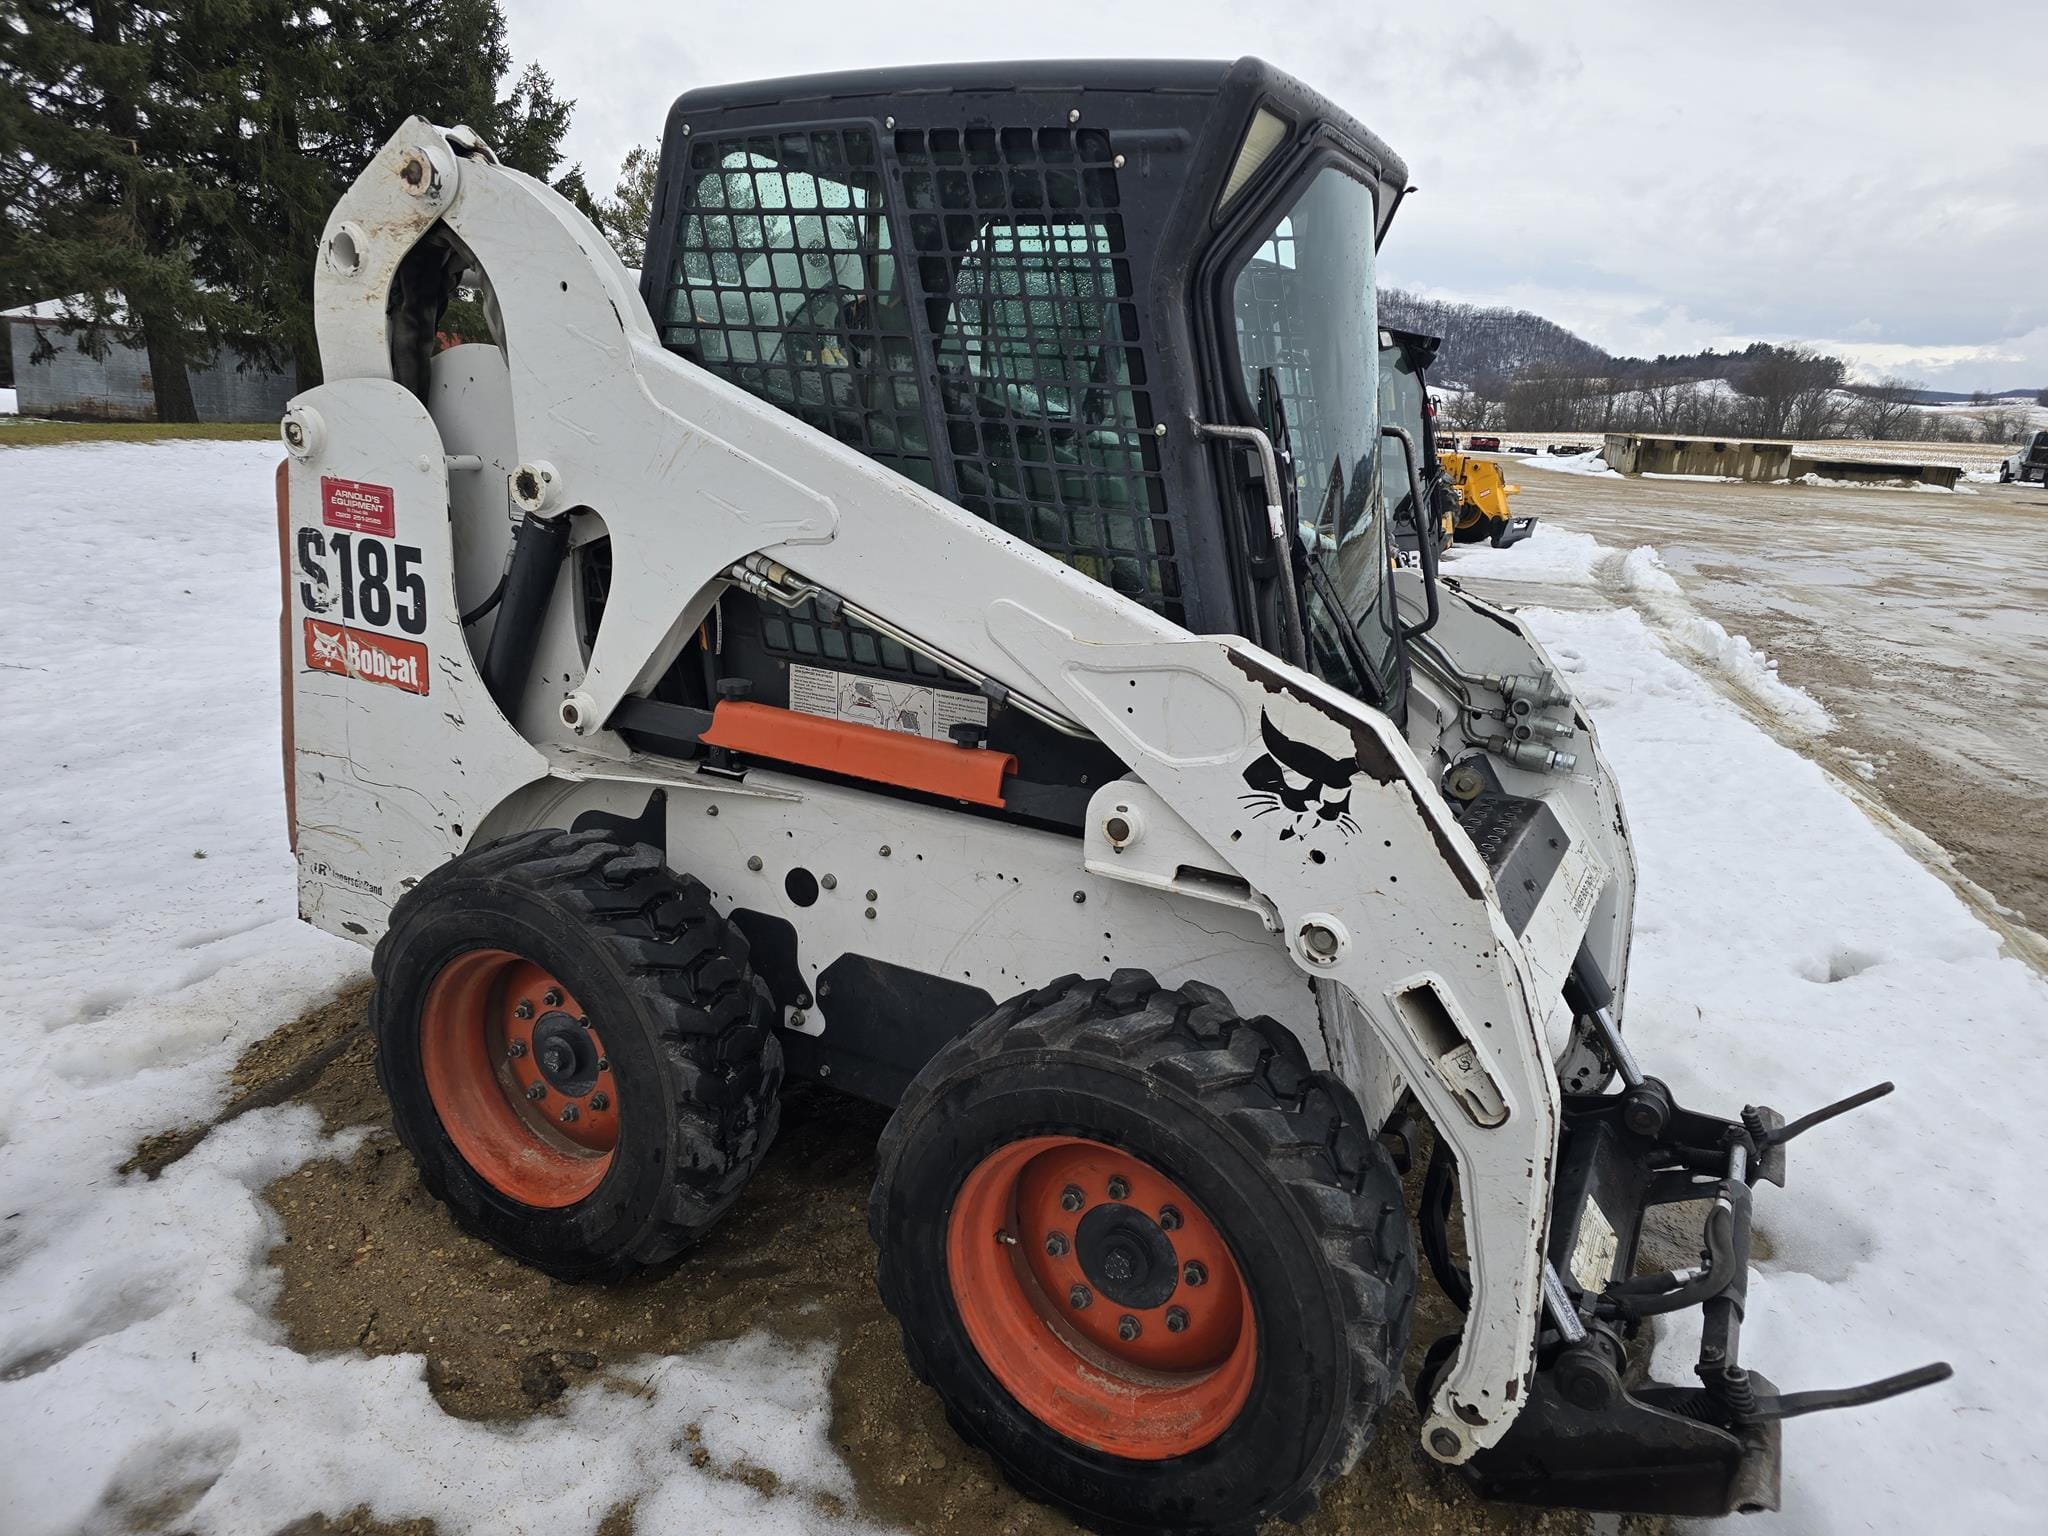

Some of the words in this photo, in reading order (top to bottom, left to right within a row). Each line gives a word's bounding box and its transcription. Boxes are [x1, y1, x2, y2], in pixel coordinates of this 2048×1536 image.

[331, 496, 384, 512] EQUIPMENT
[335, 489, 380, 504] ARNOLD'S
[298, 527, 427, 635] S185
[346, 639, 419, 687] Bobcat
